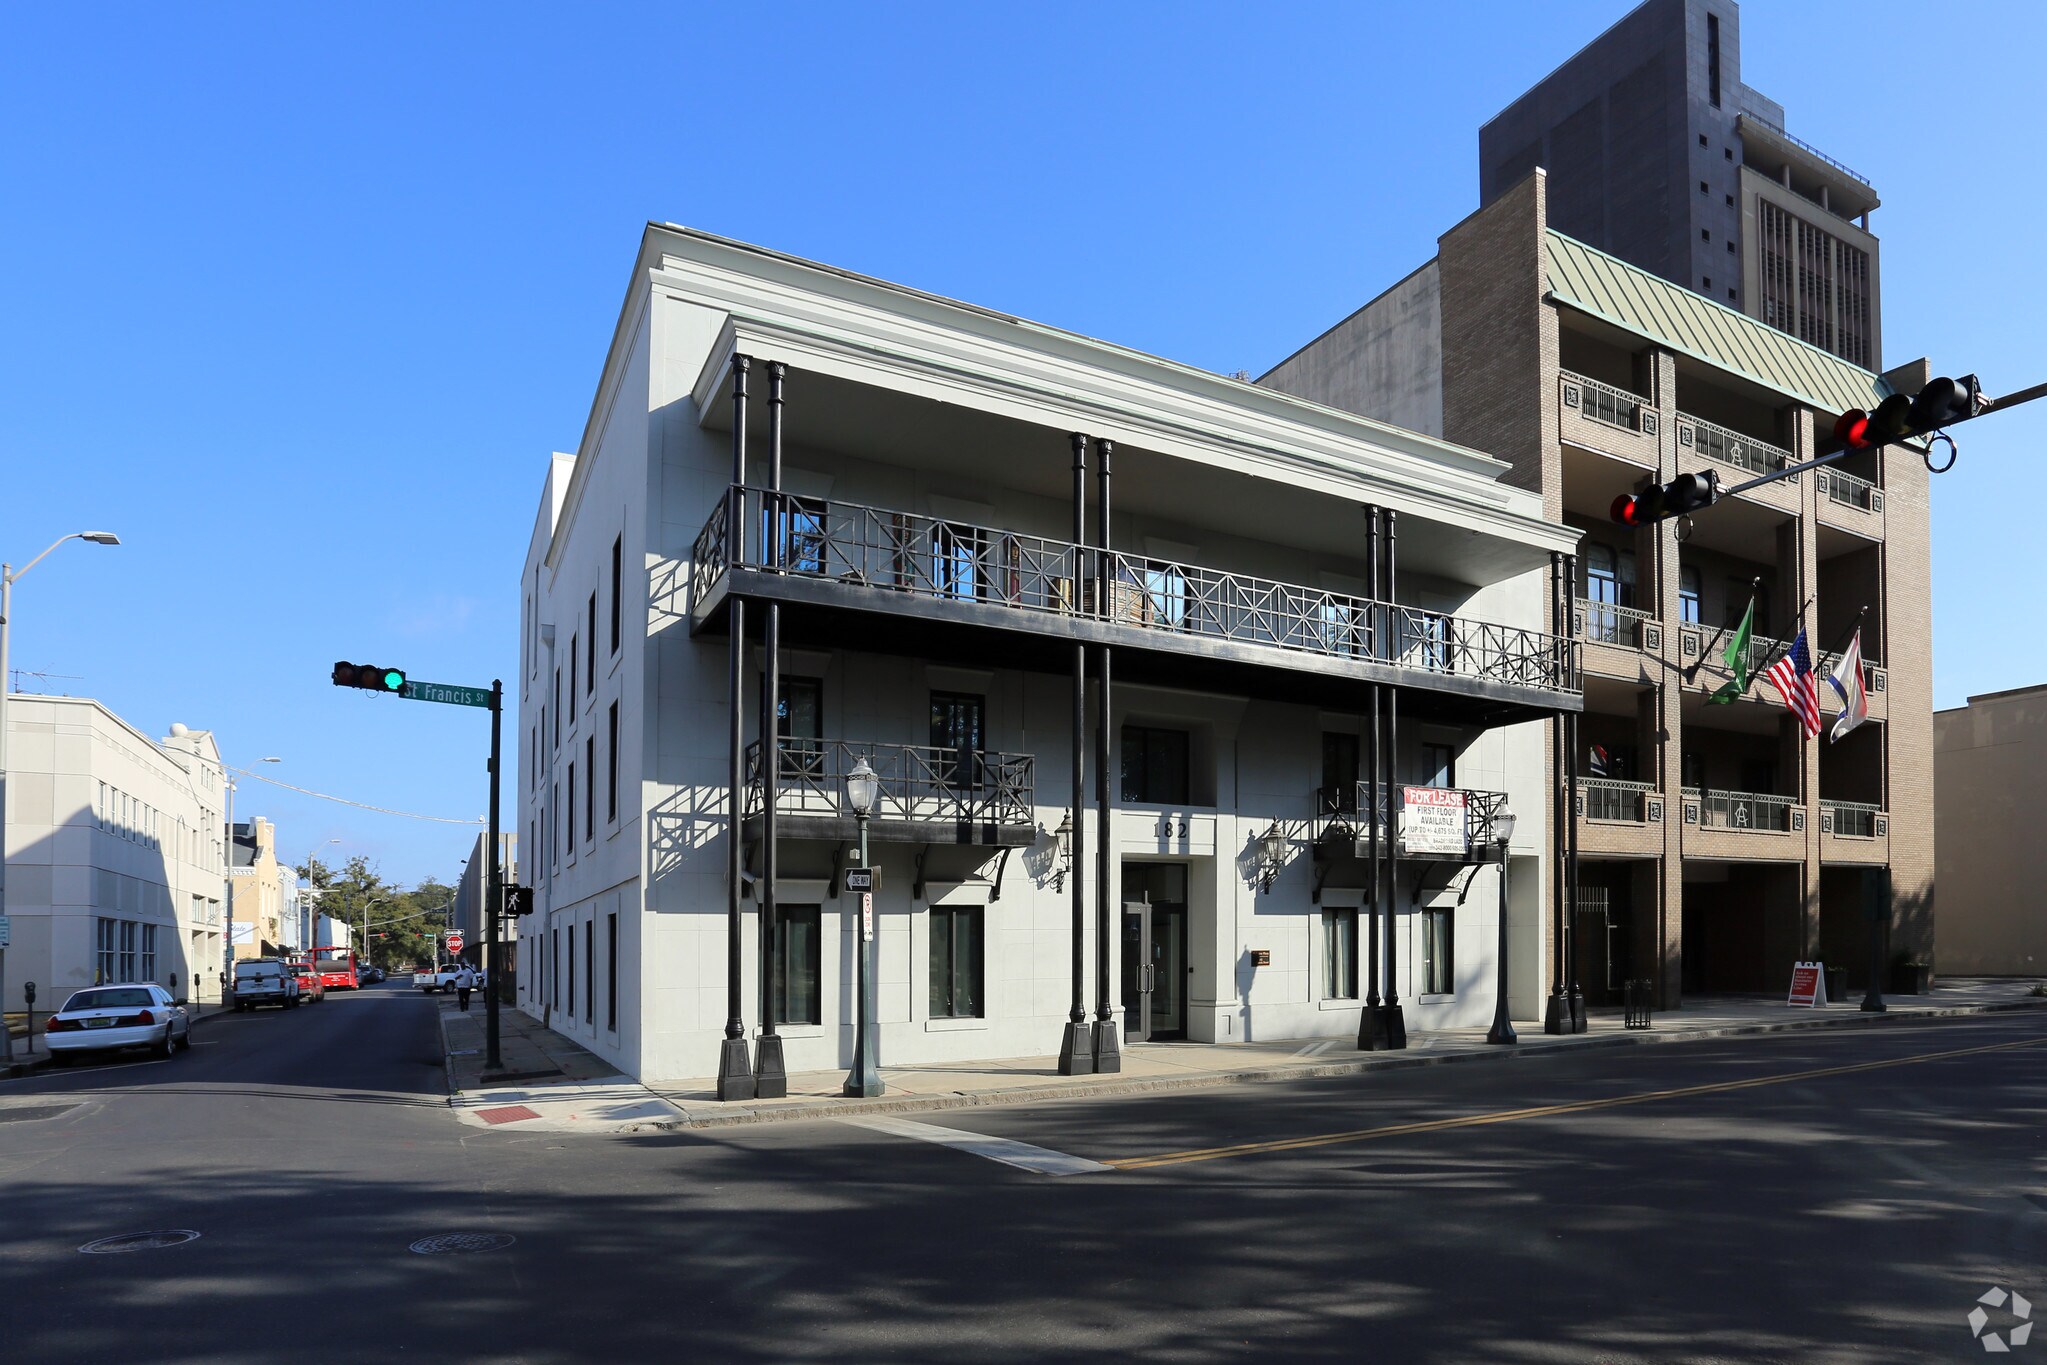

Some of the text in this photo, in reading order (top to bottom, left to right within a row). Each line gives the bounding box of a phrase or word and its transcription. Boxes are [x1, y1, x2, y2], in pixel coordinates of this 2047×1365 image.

[404, 682, 484, 704] St Francis St
[1410, 790, 1463, 806] FOR LEASE
[1417, 806, 1457, 816] FIRST FLOOR
[1420, 816, 1454, 826] AVAILABLE
[1153, 821, 1187, 839] 182
[861, 876, 869, 886] WAY
